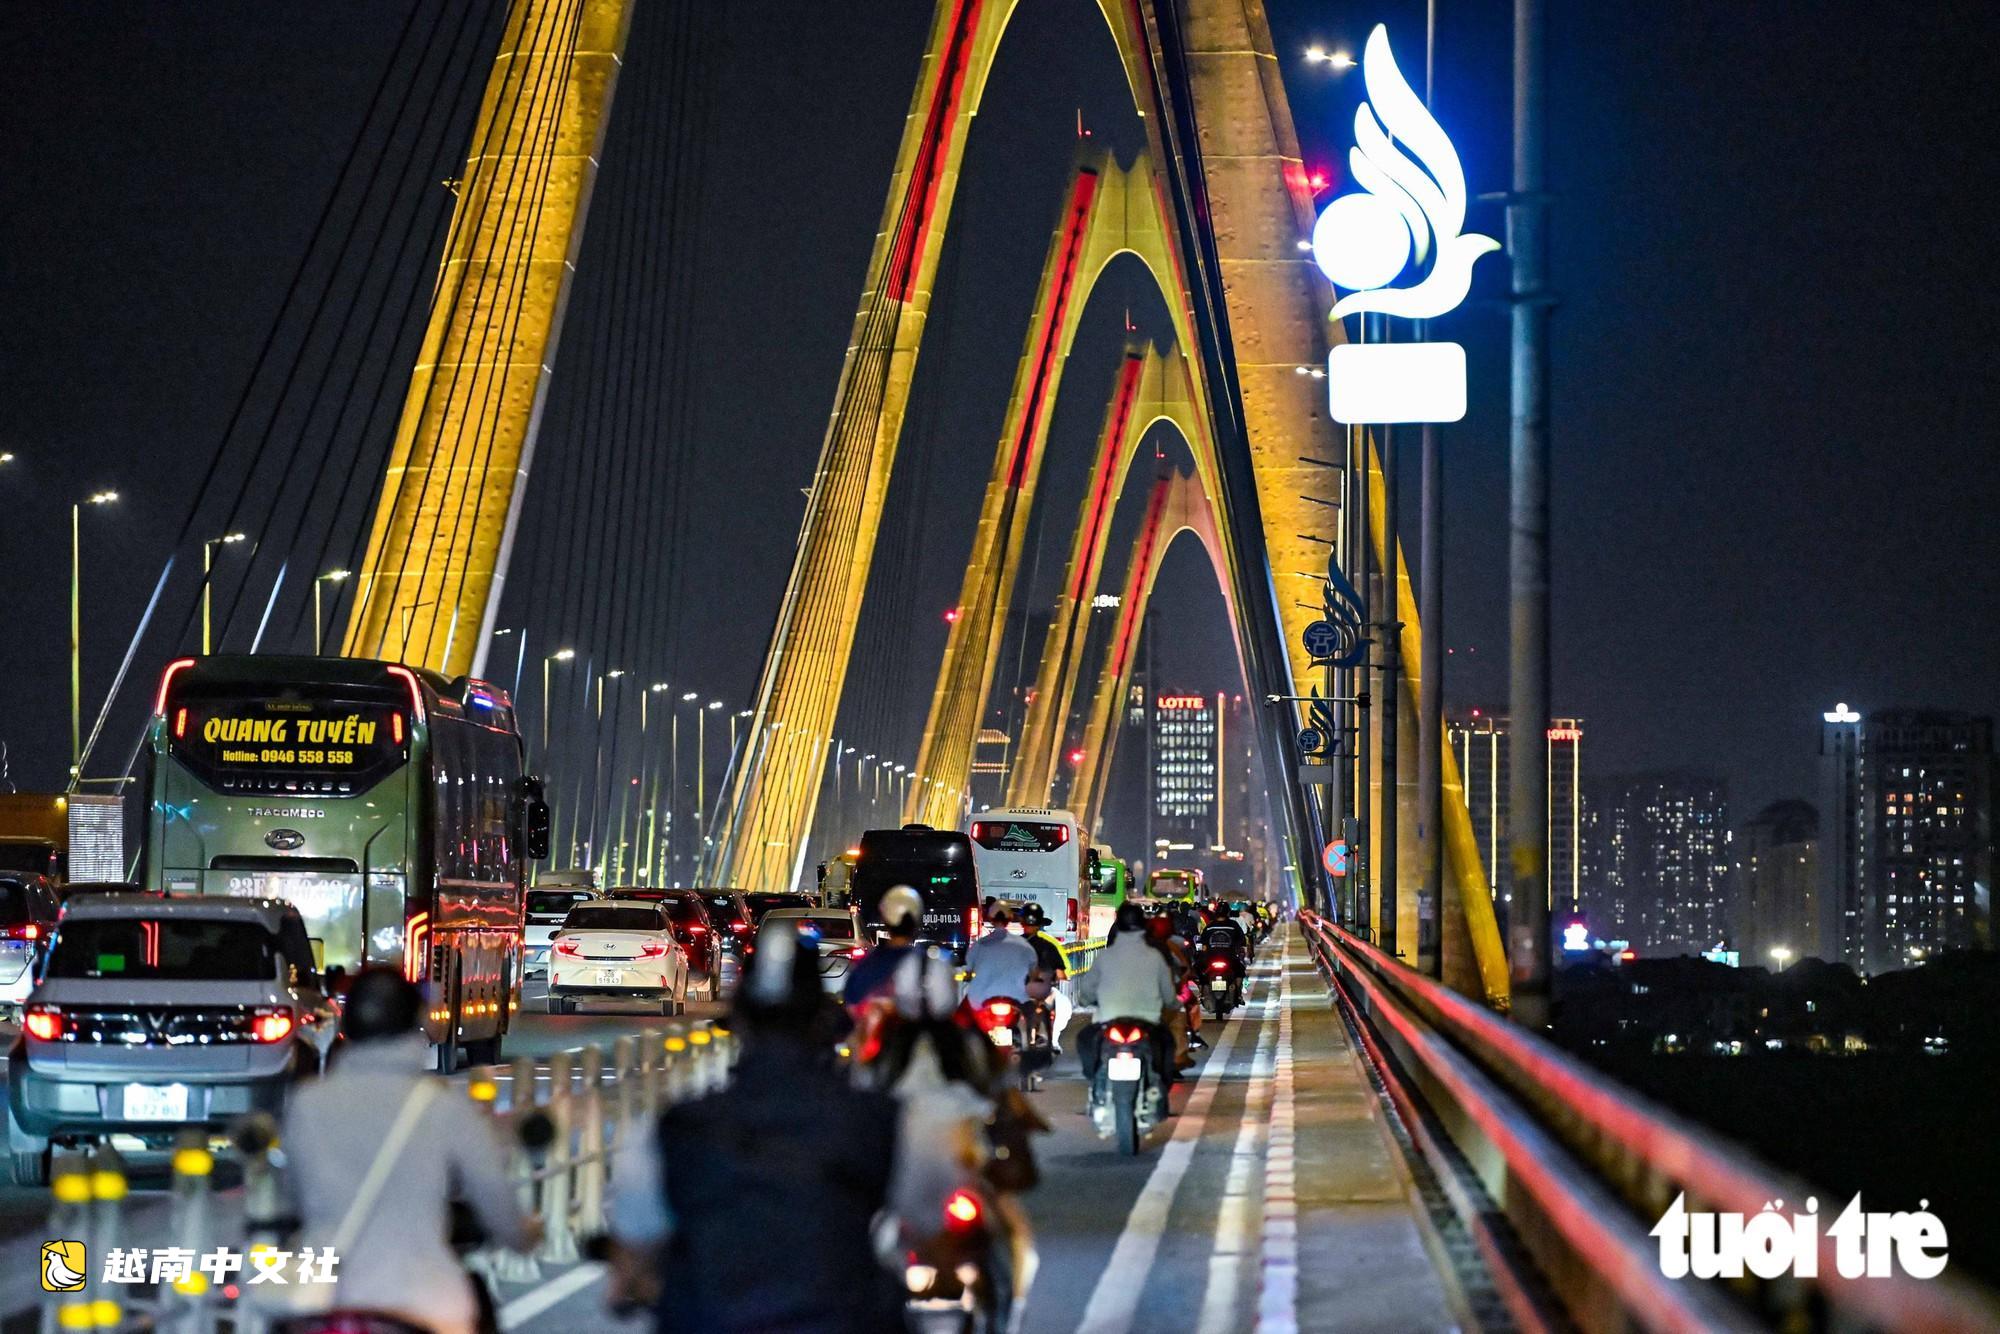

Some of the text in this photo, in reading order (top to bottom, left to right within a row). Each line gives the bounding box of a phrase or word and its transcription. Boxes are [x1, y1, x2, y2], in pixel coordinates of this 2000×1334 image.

[1158, 697, 1204, 709] LOTTE
[203, 714, 376, 744] QUANG TUYẾN
[1547, 729, 1580, 741] LOTTE
[223, 749, 353, 764] Hotline: 0946 558 558
[248, 808, 326, 819] TRACOMECO
